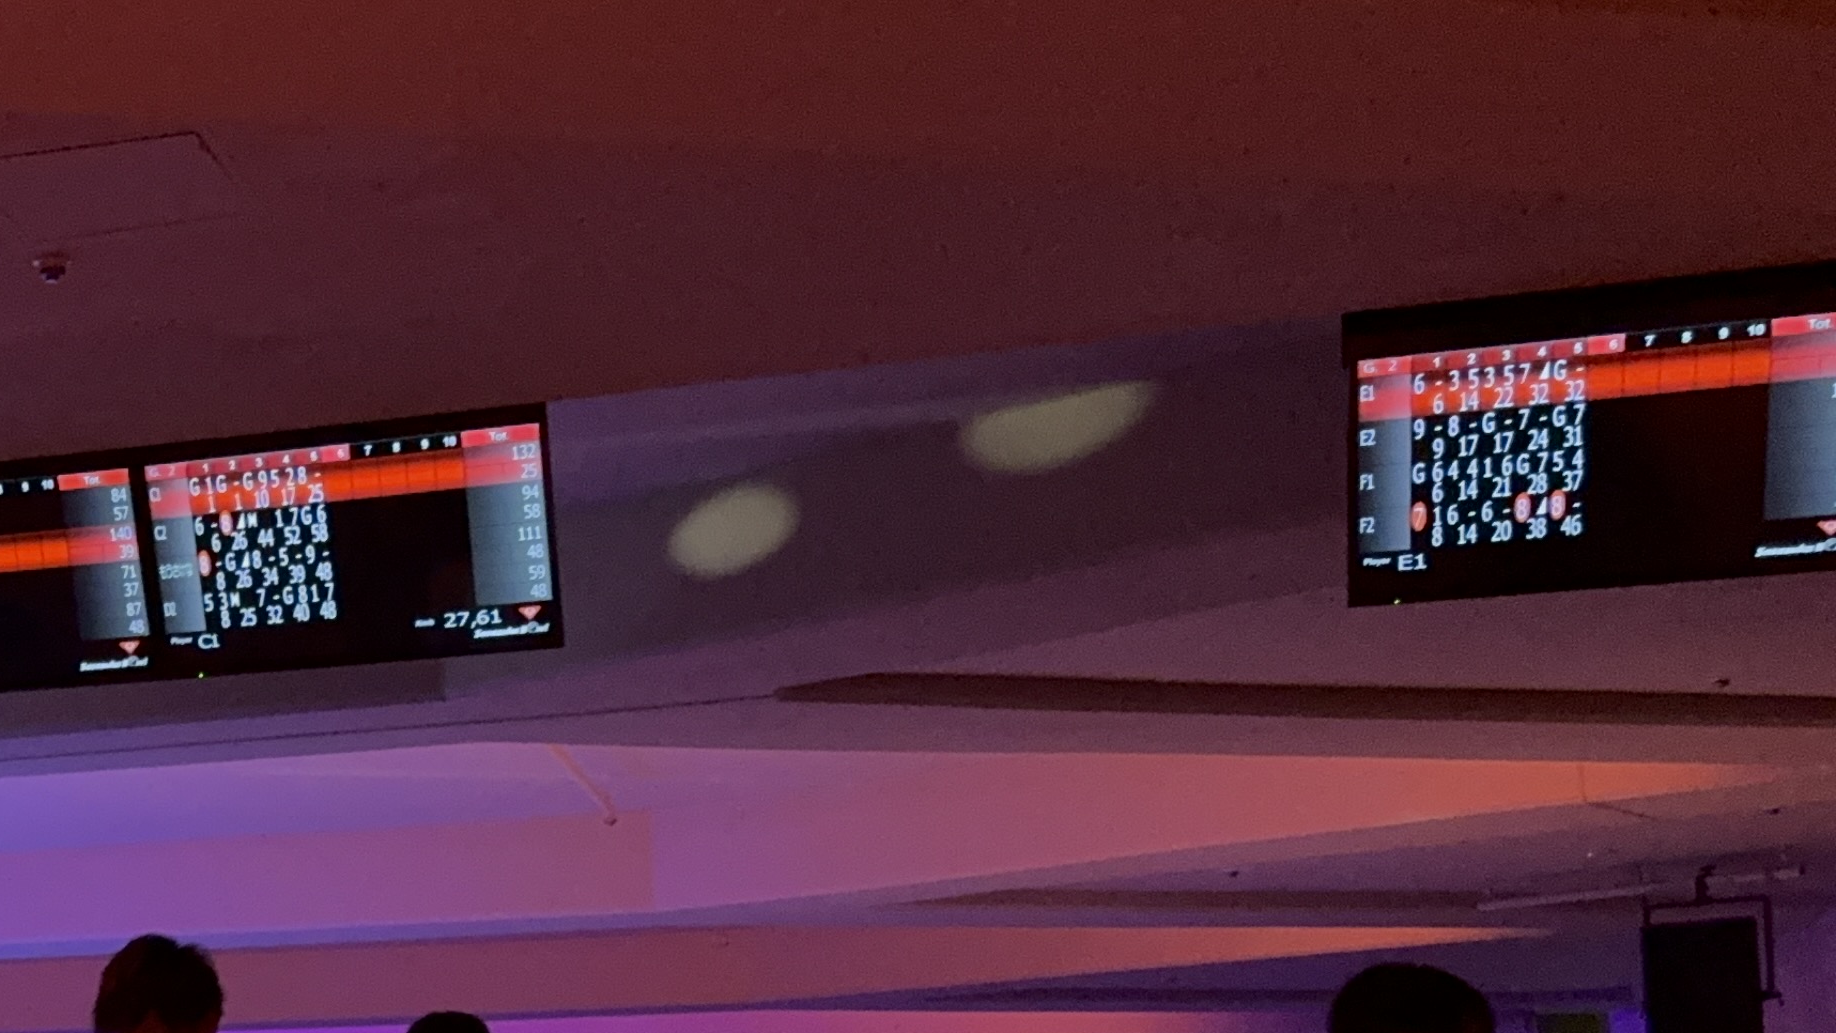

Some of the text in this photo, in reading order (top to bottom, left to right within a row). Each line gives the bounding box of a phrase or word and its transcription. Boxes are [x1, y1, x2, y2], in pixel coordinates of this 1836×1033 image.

[1433, 357, 1440, 368] 1
[1467, 353, 1476, 365] 2
[1502, 350, 1511, 361] 3
[1538, 346, 1546, 358] 4
[1574, 342, 1582, 354] 5
[1609, 339, 1618, 350] 6
[1644, 335, 1656, 347] 7
[1681, 330, 1692, 344] 8
[1718, 327, 1730, 339] 9
[1747, 324, 1765, 336] 10
[1433, 380, 1585, 414] 6 14 22 32 32
[1360, 429, 1376, 446] E2
[1432, 426, 1583, 459] 9 17 17 24 31
[512, 444, 536, 460] 132
[1360, 474, 1375, 490] F1
[1432, 469, 1583, 503] 6 14 21 28 37
[111, 488, 126, 503] 84
[254, 490, 270, 508] 10
[281, 488, 295, 506] 17
[308, 484, 324, 503] 25
[522, 485, 538, 500] 94
[114, 506, 128, 521] 57
[524, 504, 540, 519] 58
[1360, 517, 1374, 534] F2
[1432, 514, 1582, 547] 8 14 20 38 46
[110, 526, 132, 542] 140
[211, 524, 328, 553] 6 26 44 52 58
[518, 526, 542, 542] 111
[527, 543, 544, 558] 48
[120, 564, 136, 578] 71
[1398, 554, 1428, 572] E1
[216, 562, 332, 590] 8 26 34 39 48
[528, 564, 546, 580] 59
[124, 582, 139, 597] 37
[530, 583, 548, 598] 48
[126, 602, 142, 616] 87
[221, 600, 337, 628] 8 25 32 40 48
[444, 608, 502, 629] 27,61
[198, 633, 220, 649] C1
